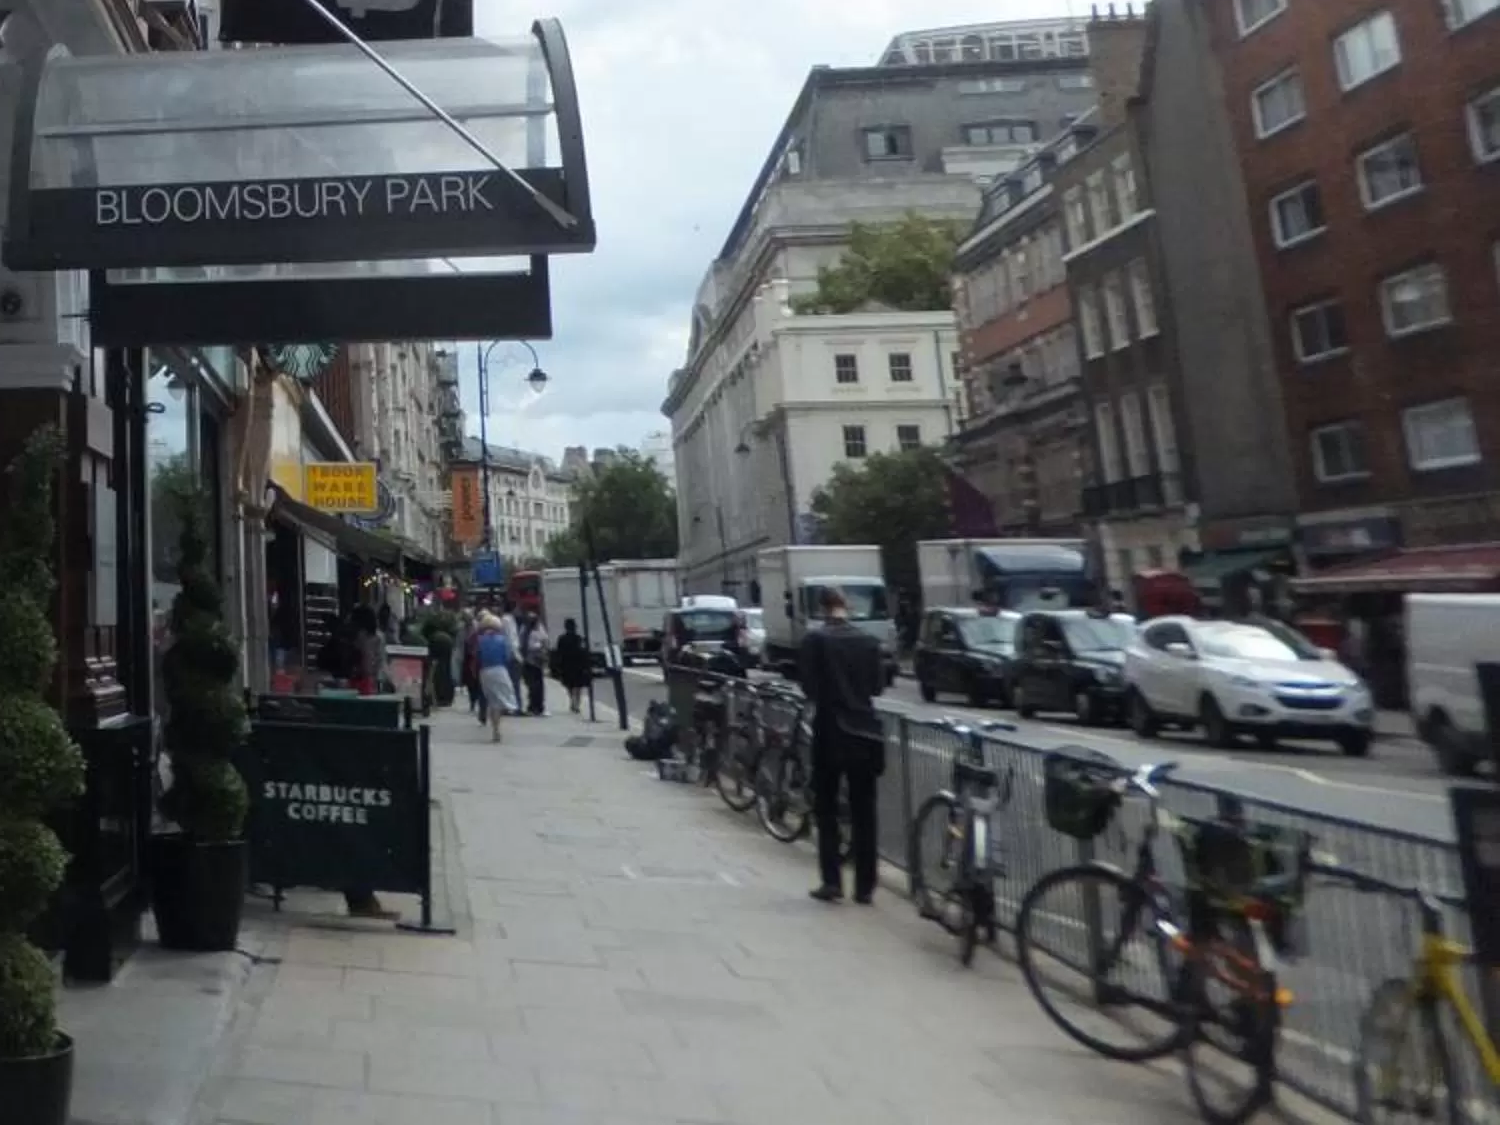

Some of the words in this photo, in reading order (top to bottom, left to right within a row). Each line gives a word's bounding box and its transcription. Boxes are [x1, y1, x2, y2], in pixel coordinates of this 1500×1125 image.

[96, 180, 372, 224] BLOOMSBURY
[386, 176, 493, 213] PARK
[263, 781, 392, 806] STARBUCKS
[287, 802, 369, 824] COFFEE
